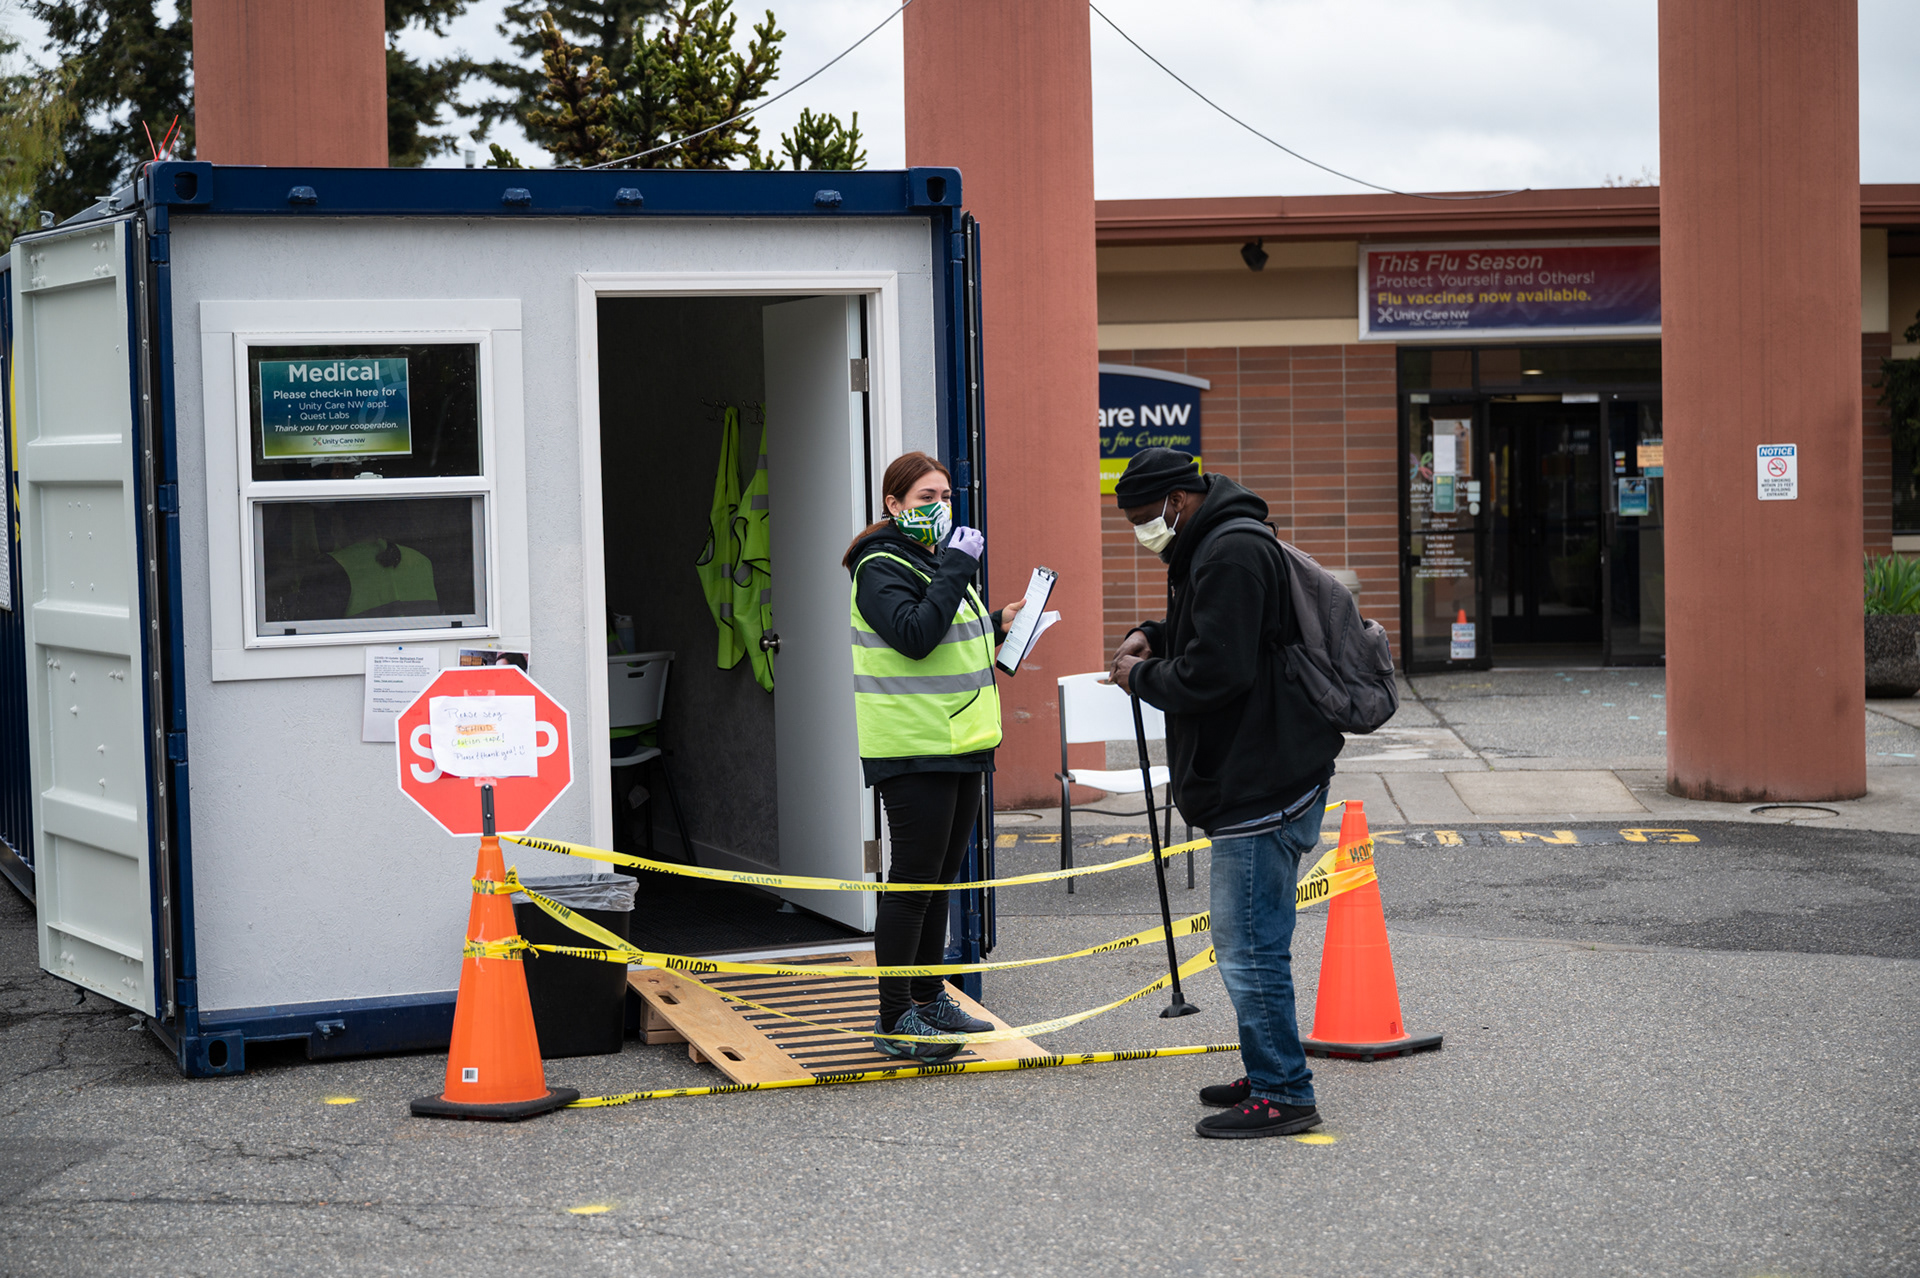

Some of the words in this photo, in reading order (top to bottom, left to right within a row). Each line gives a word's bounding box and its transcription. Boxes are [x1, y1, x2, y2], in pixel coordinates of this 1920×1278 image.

[1377, 255, 1419, 272] This
[1425, 253, 1460, 272] Flu
[1466, 252, 1543, 271] Season
[1376, 273, 1432, 288] Protect
[1438, 272, 1500, 287] Yourself
[1504, 272, 1533, 286] and
[1538, 270, 1595, 285] Others!
[1377, 292, 1402, 306] Flu
[1407, 291, 1474, 305] vaccines
[1479, 292, 1512, 304] now
[1516, 288, 1591, 303] available.
[1394, 309, 1422, 321] Unity
[1423, 309, 1448, 320] Care
[1450, 309, 1469, 319] NW
[289, 361, 380, 383] Medical
[273, 390, 307, 399] Please
[309, 388, 353, 398] check-in
[355, 388, 379, 397] here
[381, 387, 397, 396] for
[299, 402, 322, 412] Unity
[367, 400, 389, 409] appt.
[1140, 403, 1191, 427] NW
[299, 412, 326, 421] Quest
[329, 411, 350, 420] Labs
[274, 424, 298, 432] Thank
[300, 425, 315, 433] you
[316, 424, 328, 432] for
[330, 424, 348, 432] your
[350, 421, 398, 430] cooperation.
[1107, 431, 1132, 454] for
[1760, 447, 1793, 456] NOTICE
[456, 724, 493, 732] BEHIND
[410, 721, 559, 783] SP
[516, 837, 571, 855] CAUTION
